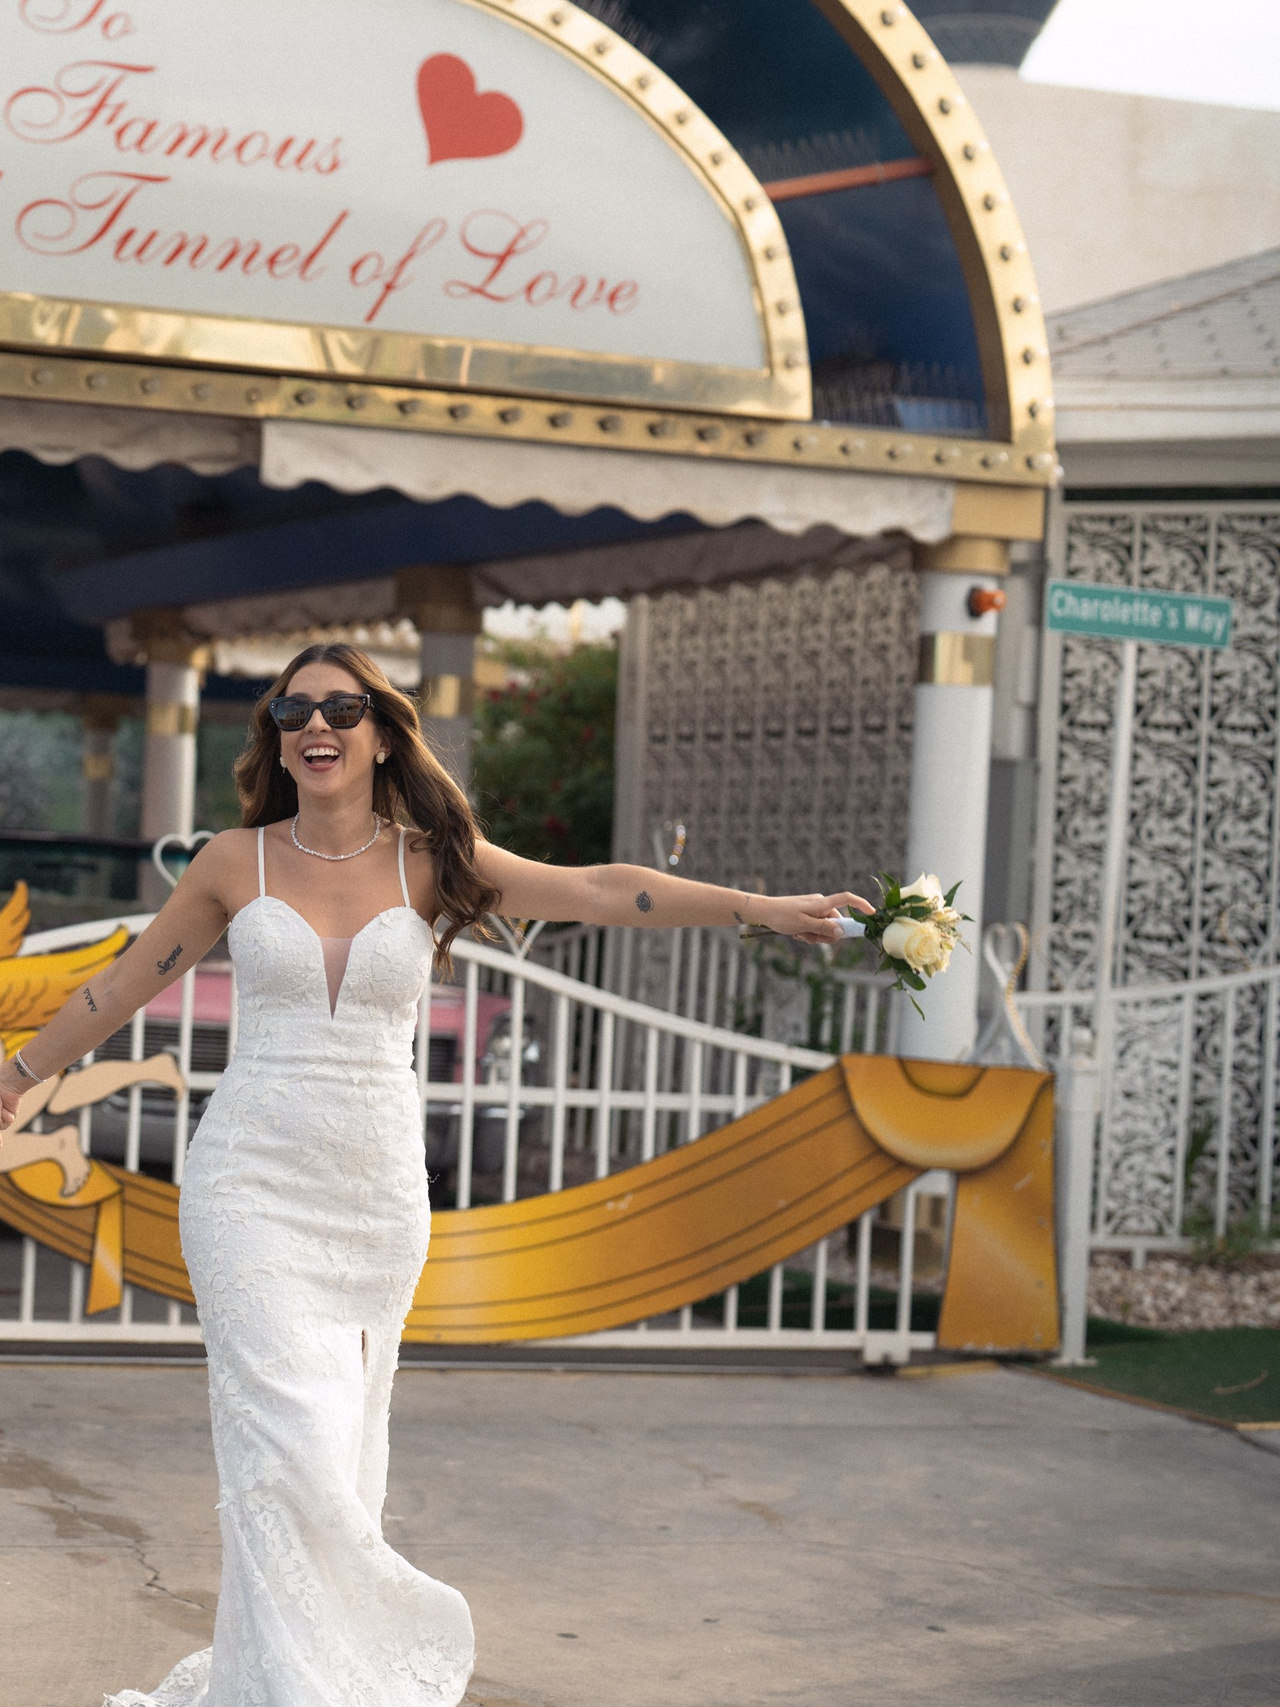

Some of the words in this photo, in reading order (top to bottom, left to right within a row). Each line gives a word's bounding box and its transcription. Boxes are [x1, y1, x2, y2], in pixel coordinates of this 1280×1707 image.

[4, 59, 345, 177] Famous
[14, 170, 351, 285] Tunnel
[348, 216, 448, 323] of
[442, 208, 641, 317] Love
[1184, 603, 1228, 642] Way
